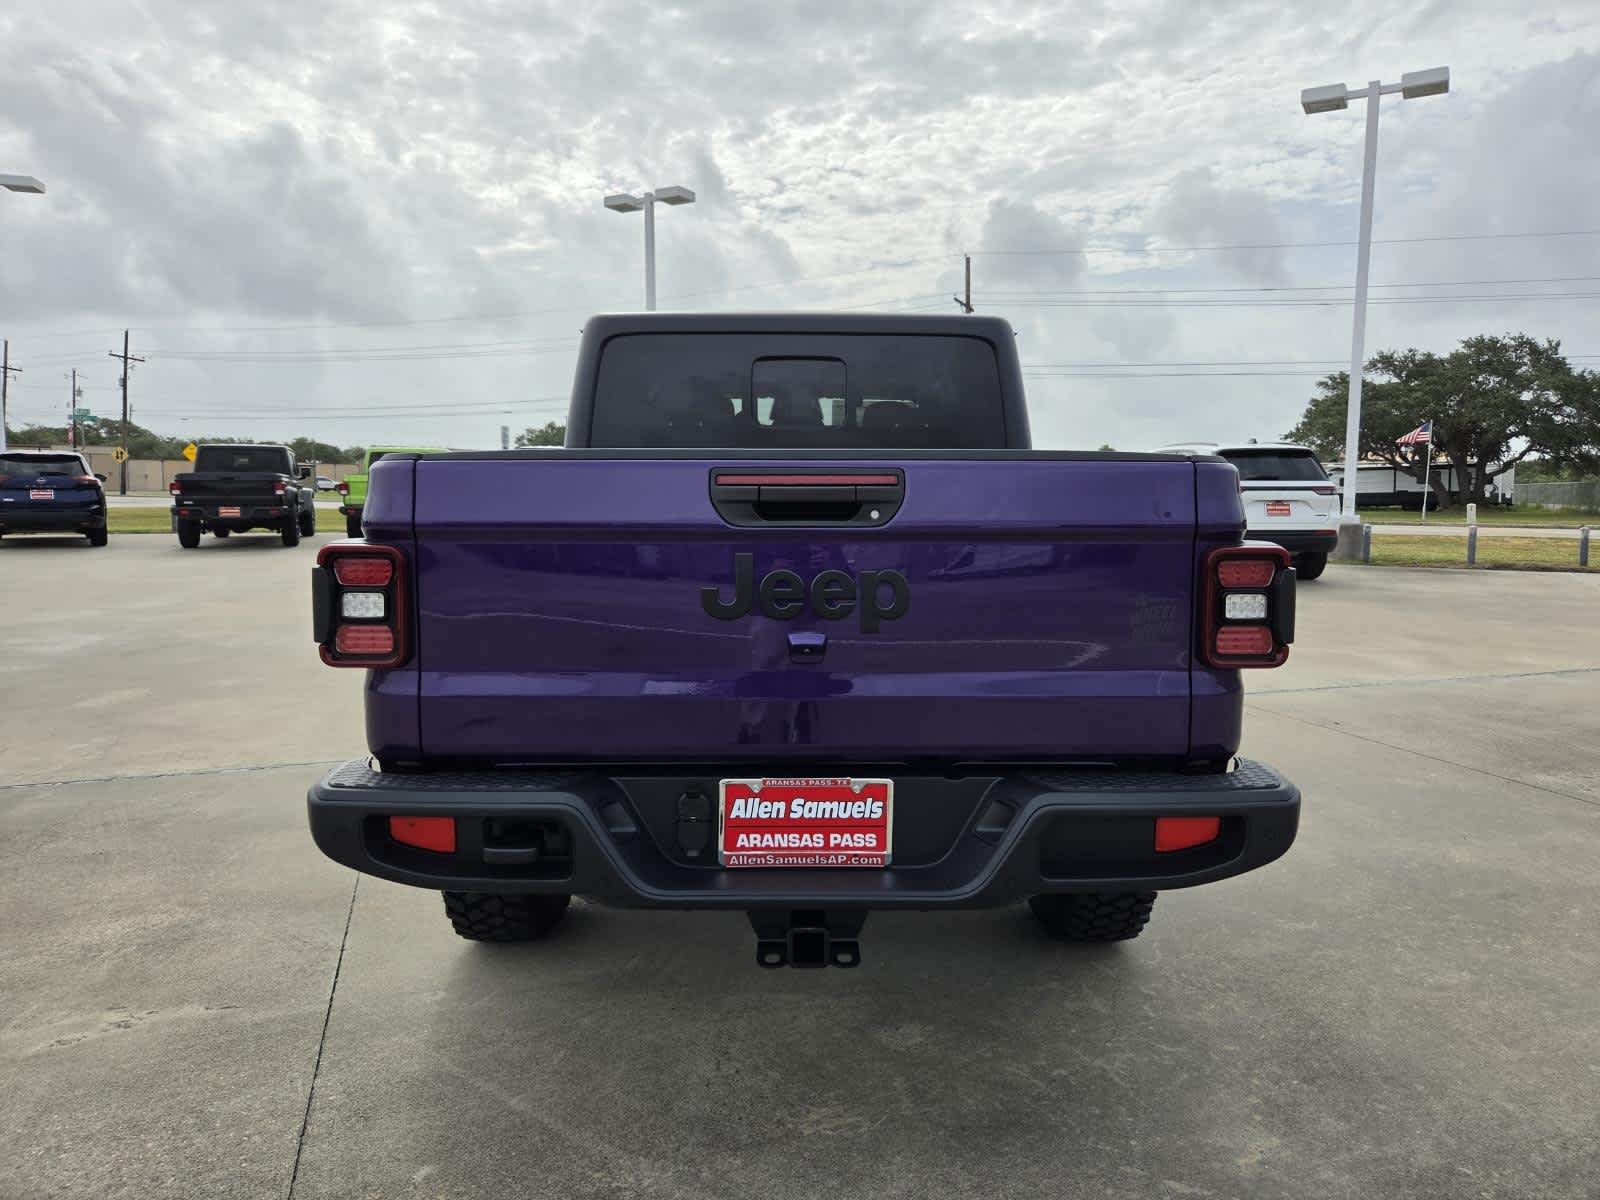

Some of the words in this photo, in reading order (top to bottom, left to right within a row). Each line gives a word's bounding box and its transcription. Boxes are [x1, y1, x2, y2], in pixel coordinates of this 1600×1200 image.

[701, 552, 910, 633] Jeep
[730, 798, 786, 819] Allen
[790, 798, 883, 819] Samuels
[736, 834, 824, 848] ARANSAS
[830, 834, 877, 848] PASS
[729, 855, 882, 865] AllenSamuelsAP.com
